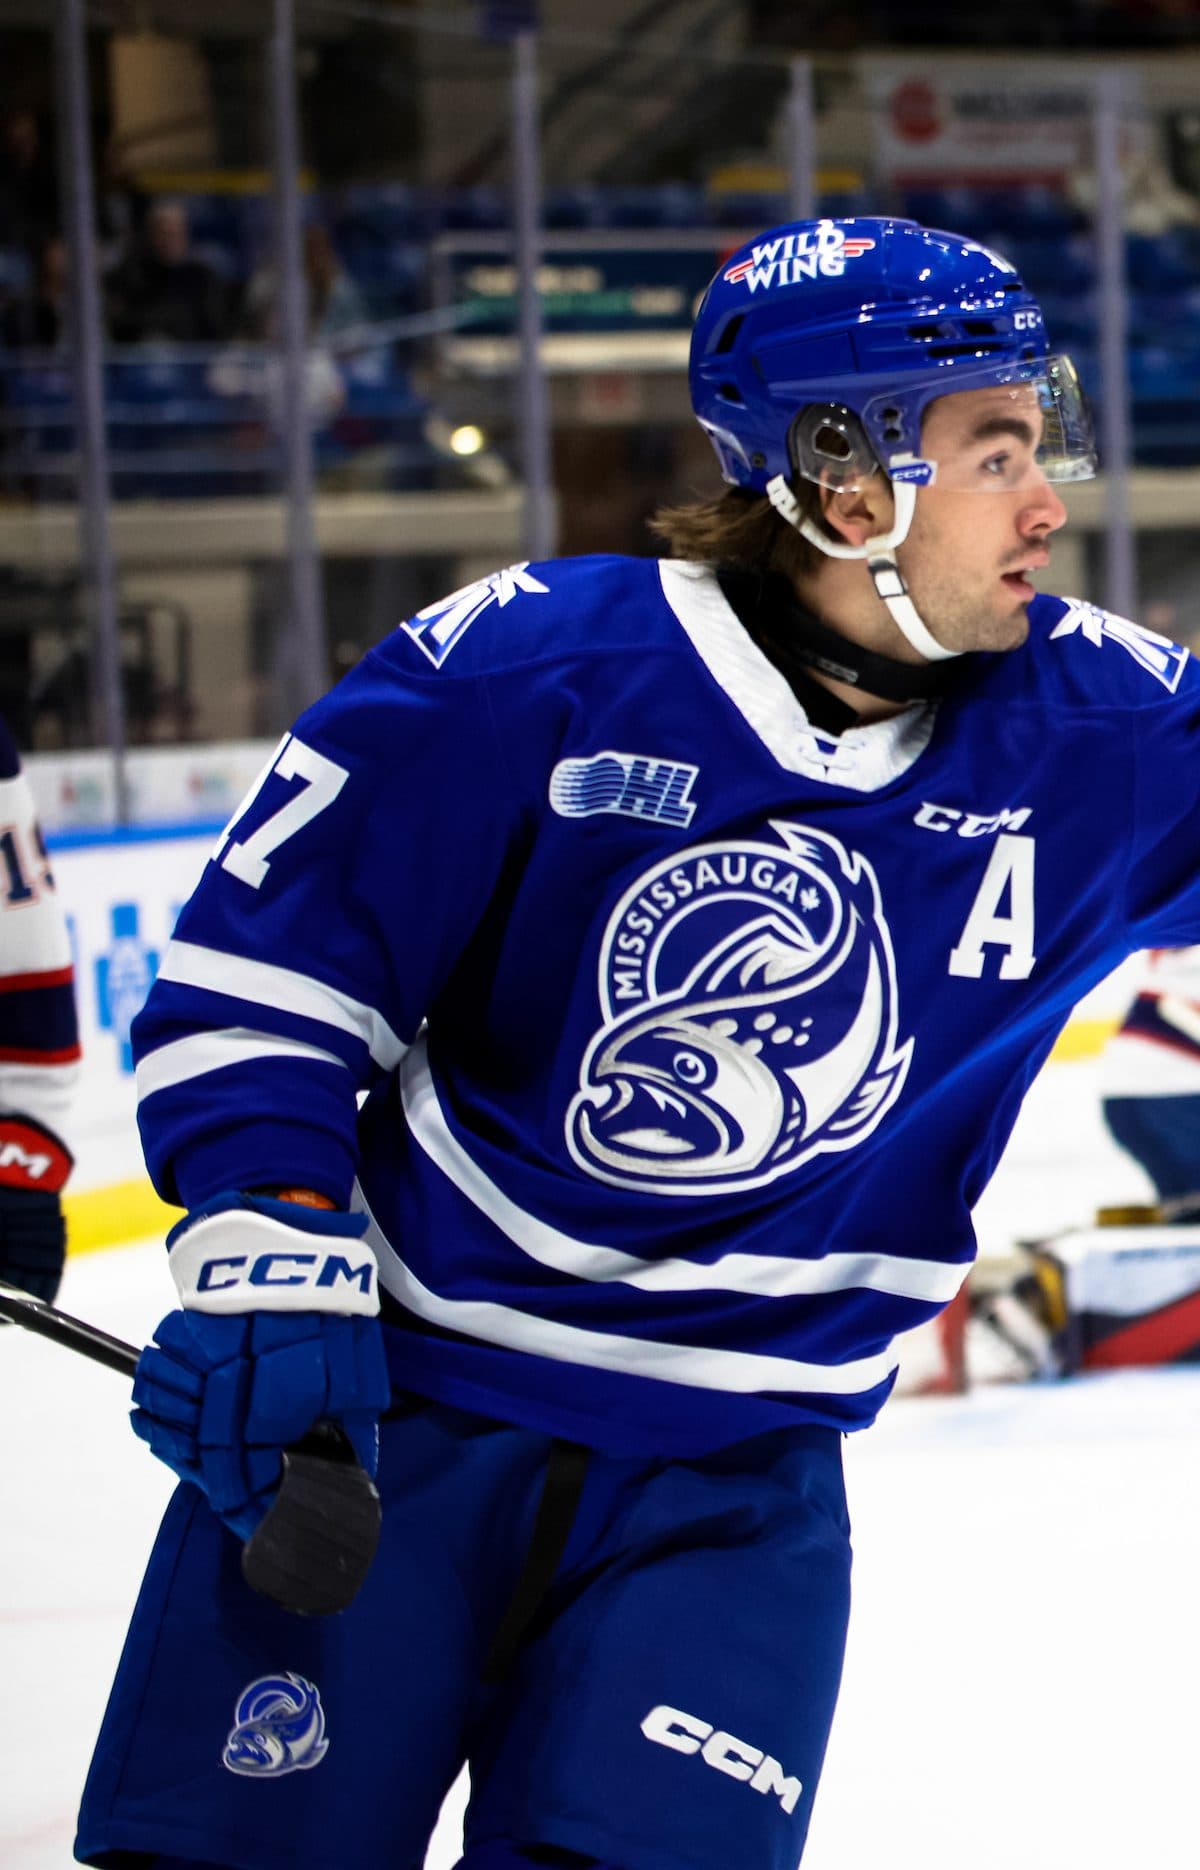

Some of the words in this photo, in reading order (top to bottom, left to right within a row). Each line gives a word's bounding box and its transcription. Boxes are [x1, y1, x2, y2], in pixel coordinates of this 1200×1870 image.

[751, 226, 846, 267] WILD
[745, 250, 847, 294] WING
[1013, 311, 1042, 331] CC
[548, 750, 700, 830] OHL
[913, 801, 1034, 838] CCM
[613, 854, 801, 1001] MISSISSAUGA
[948, 833, 1037, 980] A
[196, 1252, 374, 1296] CCM
[640, 1704, 803, 1816] CCM
